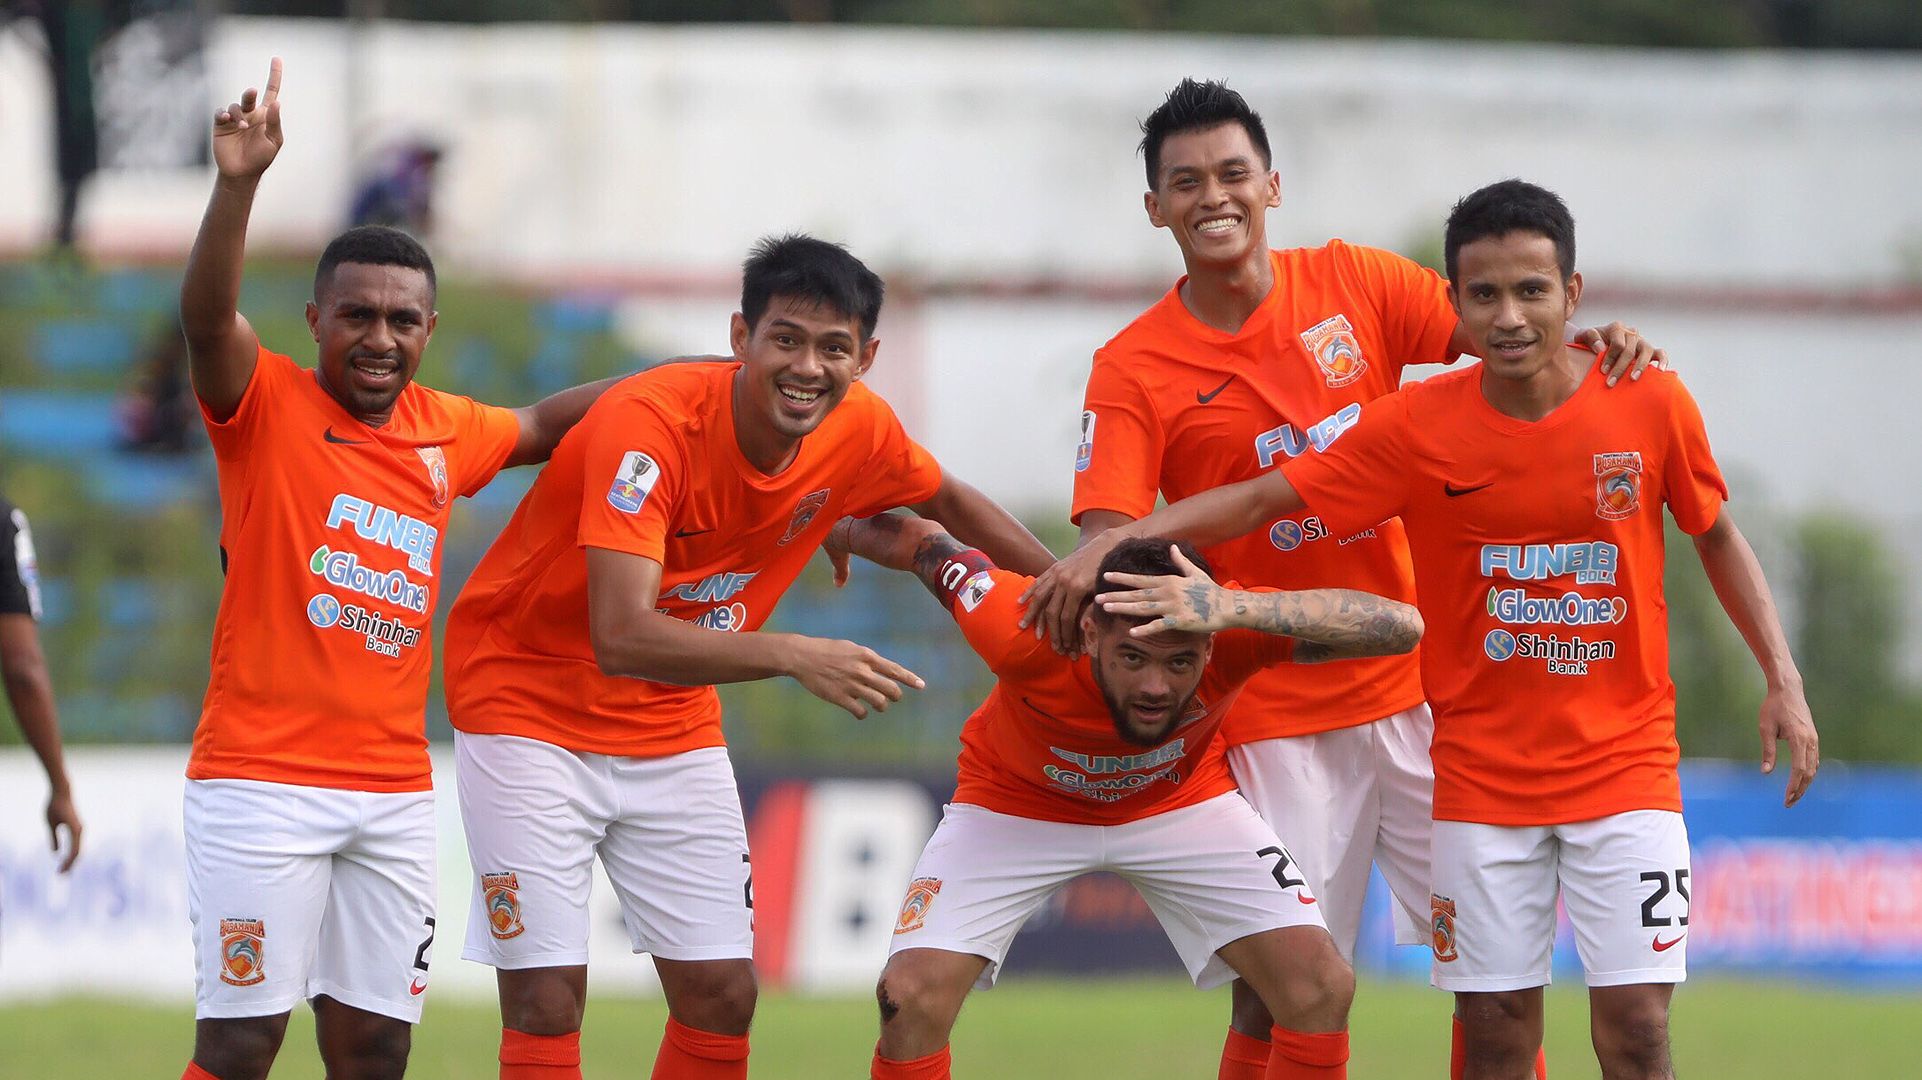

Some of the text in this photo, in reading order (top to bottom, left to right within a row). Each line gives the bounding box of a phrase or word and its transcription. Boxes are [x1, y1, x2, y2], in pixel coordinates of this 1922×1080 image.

[326, 493, 438, 562] FUN88
[1481, 541, 1618, 580] FUN88
[1577, 570, 1616, 586] BOLA
[324, 550, 424, 612] GlowOne
[1495, 588, 1613, 626] GlowOne
[366, 636, 400, 658] Bank
[1516, 633, 1615, 661] Shinhan
[1547, 659, 1589, 675] Bank
[1640, 868, 1690, 928] 25
